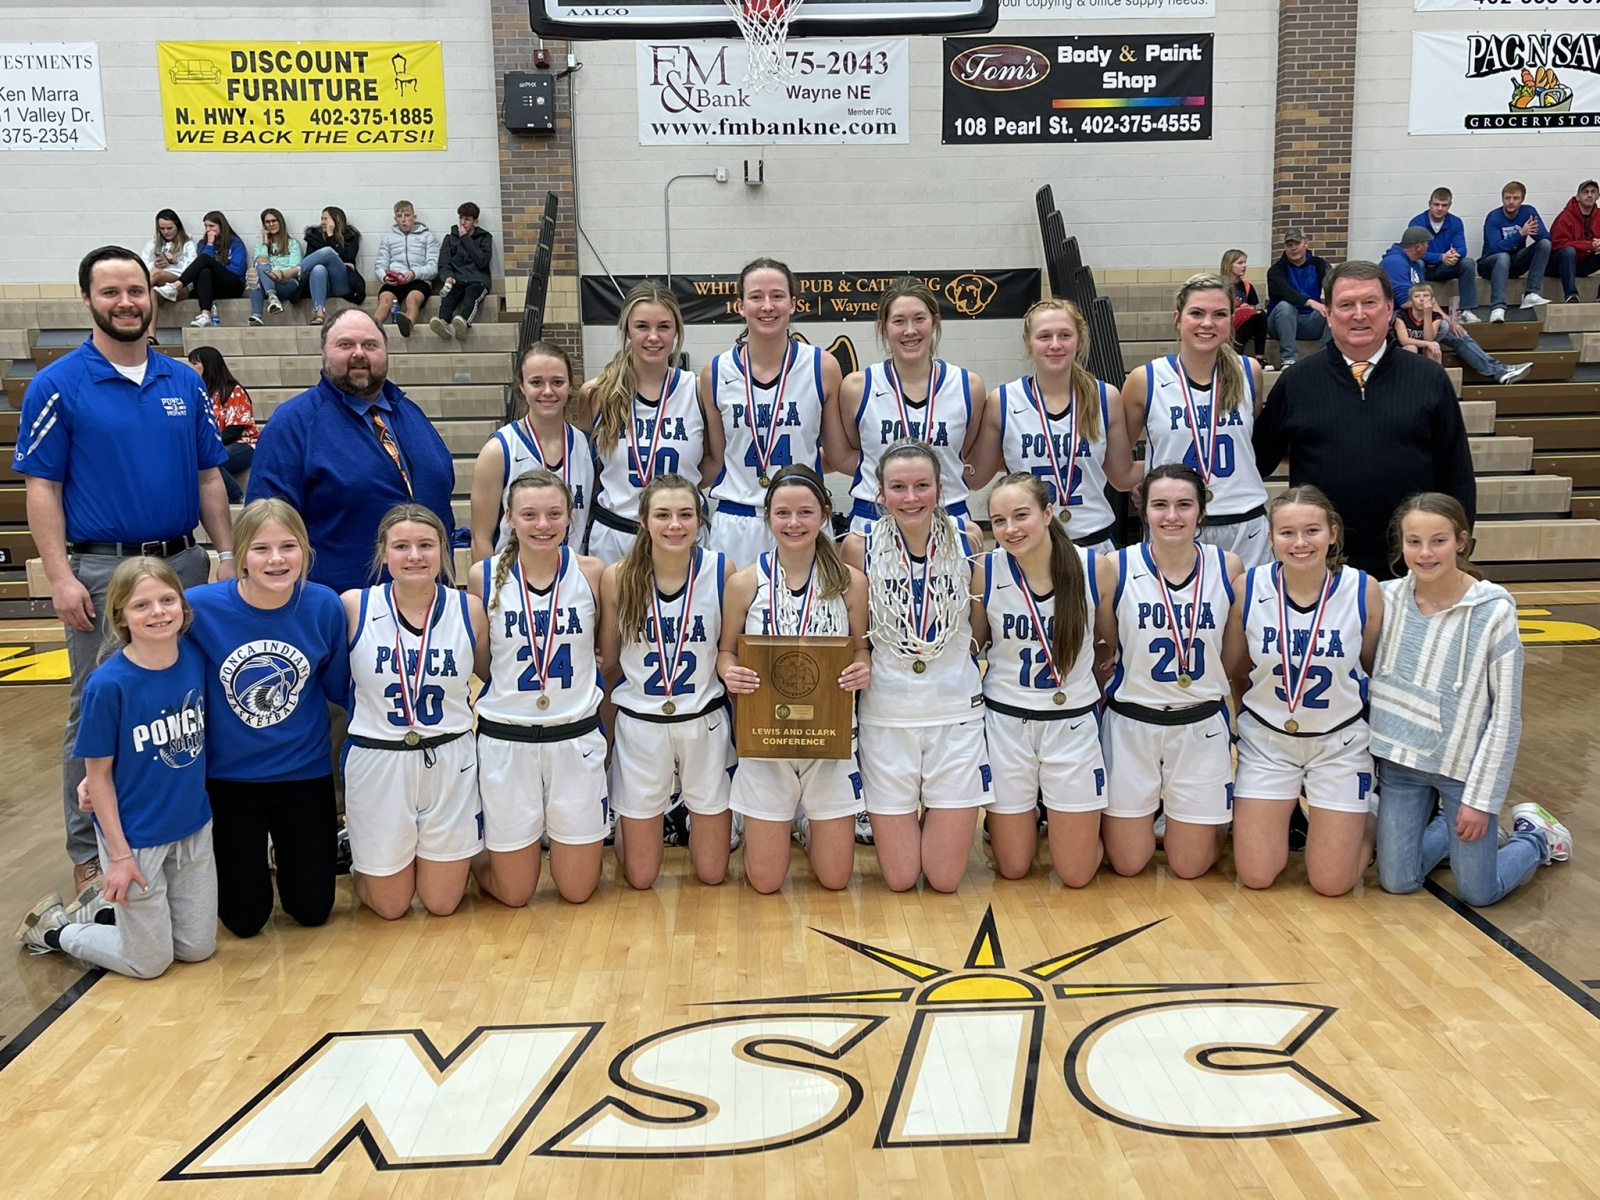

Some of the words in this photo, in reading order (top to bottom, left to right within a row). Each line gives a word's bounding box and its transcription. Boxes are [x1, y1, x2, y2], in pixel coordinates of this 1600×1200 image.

[566, 8, 630, 16] AALCO
[0, 54, 93, 70] ESTMENTS
[231, 50, 369, 73] DISCOUNT
[960, 53, 1040, 82] Tom's
[1057, 45, 1112, 67] Body
[1118, 44, 1138, 63] &
[1145, 43, 1203, 62] Paint
[31, 86, 79, 102] Marra
[227, 78, 379, 102] FURNITURE
[786, 85, 842, 103] Wayne
[847, 85, 871, 100] NE
[1102, 71, 1157, 93] Shop
[696, 88, 751, 108] Bank
[847, 107, 874, 116] Member
[875, 107, 892, 116] FDIC
[17, 107, 66, 126] Valley
[71, 107, 94, 123] Dr.
[175, 107, 196, 126] N.
[204, 107, 254, 126] HWY.
[263, 108, 286, 125] 15
[309, 107, 434, 126] 402-375-1885
[650, 117, 898, 136] www.fmbankne.com
[954, 117, 987, 135] 108
[994, 115, 1041, 135] Pearl
[1048, 115, 1074, 134] St.
[1080, 113, 1201, 134] 402-375-4555
[1469, 117, 1552, 128] GROCERY
[2, 128, 79, 144] 375-2354
[175, 130, 214, 144] WE
[222, 130, 293, 144] BACK
[301, 129, 349, 144] THE
[355, 129, 435, 144] CATS!!
[692, 280, 740, 296] WHIT
[799, 279, 834, 294] PUB
[837, 279, 852, 293] &
[796, 299, 811, 313] St
[829, 297, 879, 315] Wayne
[732, 401, 802, 429] PONCA
[628, 446, 680, 488] 50
[744, 434, 793, 477] 44
[1182, 434, 1236, 478] 40
[1031, 464, 1083, 506] 52
[504, 607, 583, 638] PONCA
[1137, 601, 1216, 630] PONCA
[1261, 626, 1345, 658] PONCA
[220, 644, 257, 684] PONCA
[263, 641, 309, 680] INDIANS
[374, 645, 458, 677] PONCA
[517, 643, 574, 692] 24
[643, 650, 697, 696] 22
[1019, 647, 1059, 689] 12
[1148, 637, 1206, 682] 20
[1272, 663, 1333, 709] 32
[226, 690, 299, 728] BASKETBALL
[384, 682, 446, 727] 30
[752, 727, 781, 736] LEWIS
[783, 728, 803, 736] AND
[805, 728, 837, 737] CLARK
[762, 737, 826, 746] CONFERENCE
[848, 771, 863, 801] P
[979, 763, 993, 792] P
[1093, 767, 1105, 797] P
[1357, 772, 1372, 800] P
[158, 1000, 1380, 1182] NSIC
